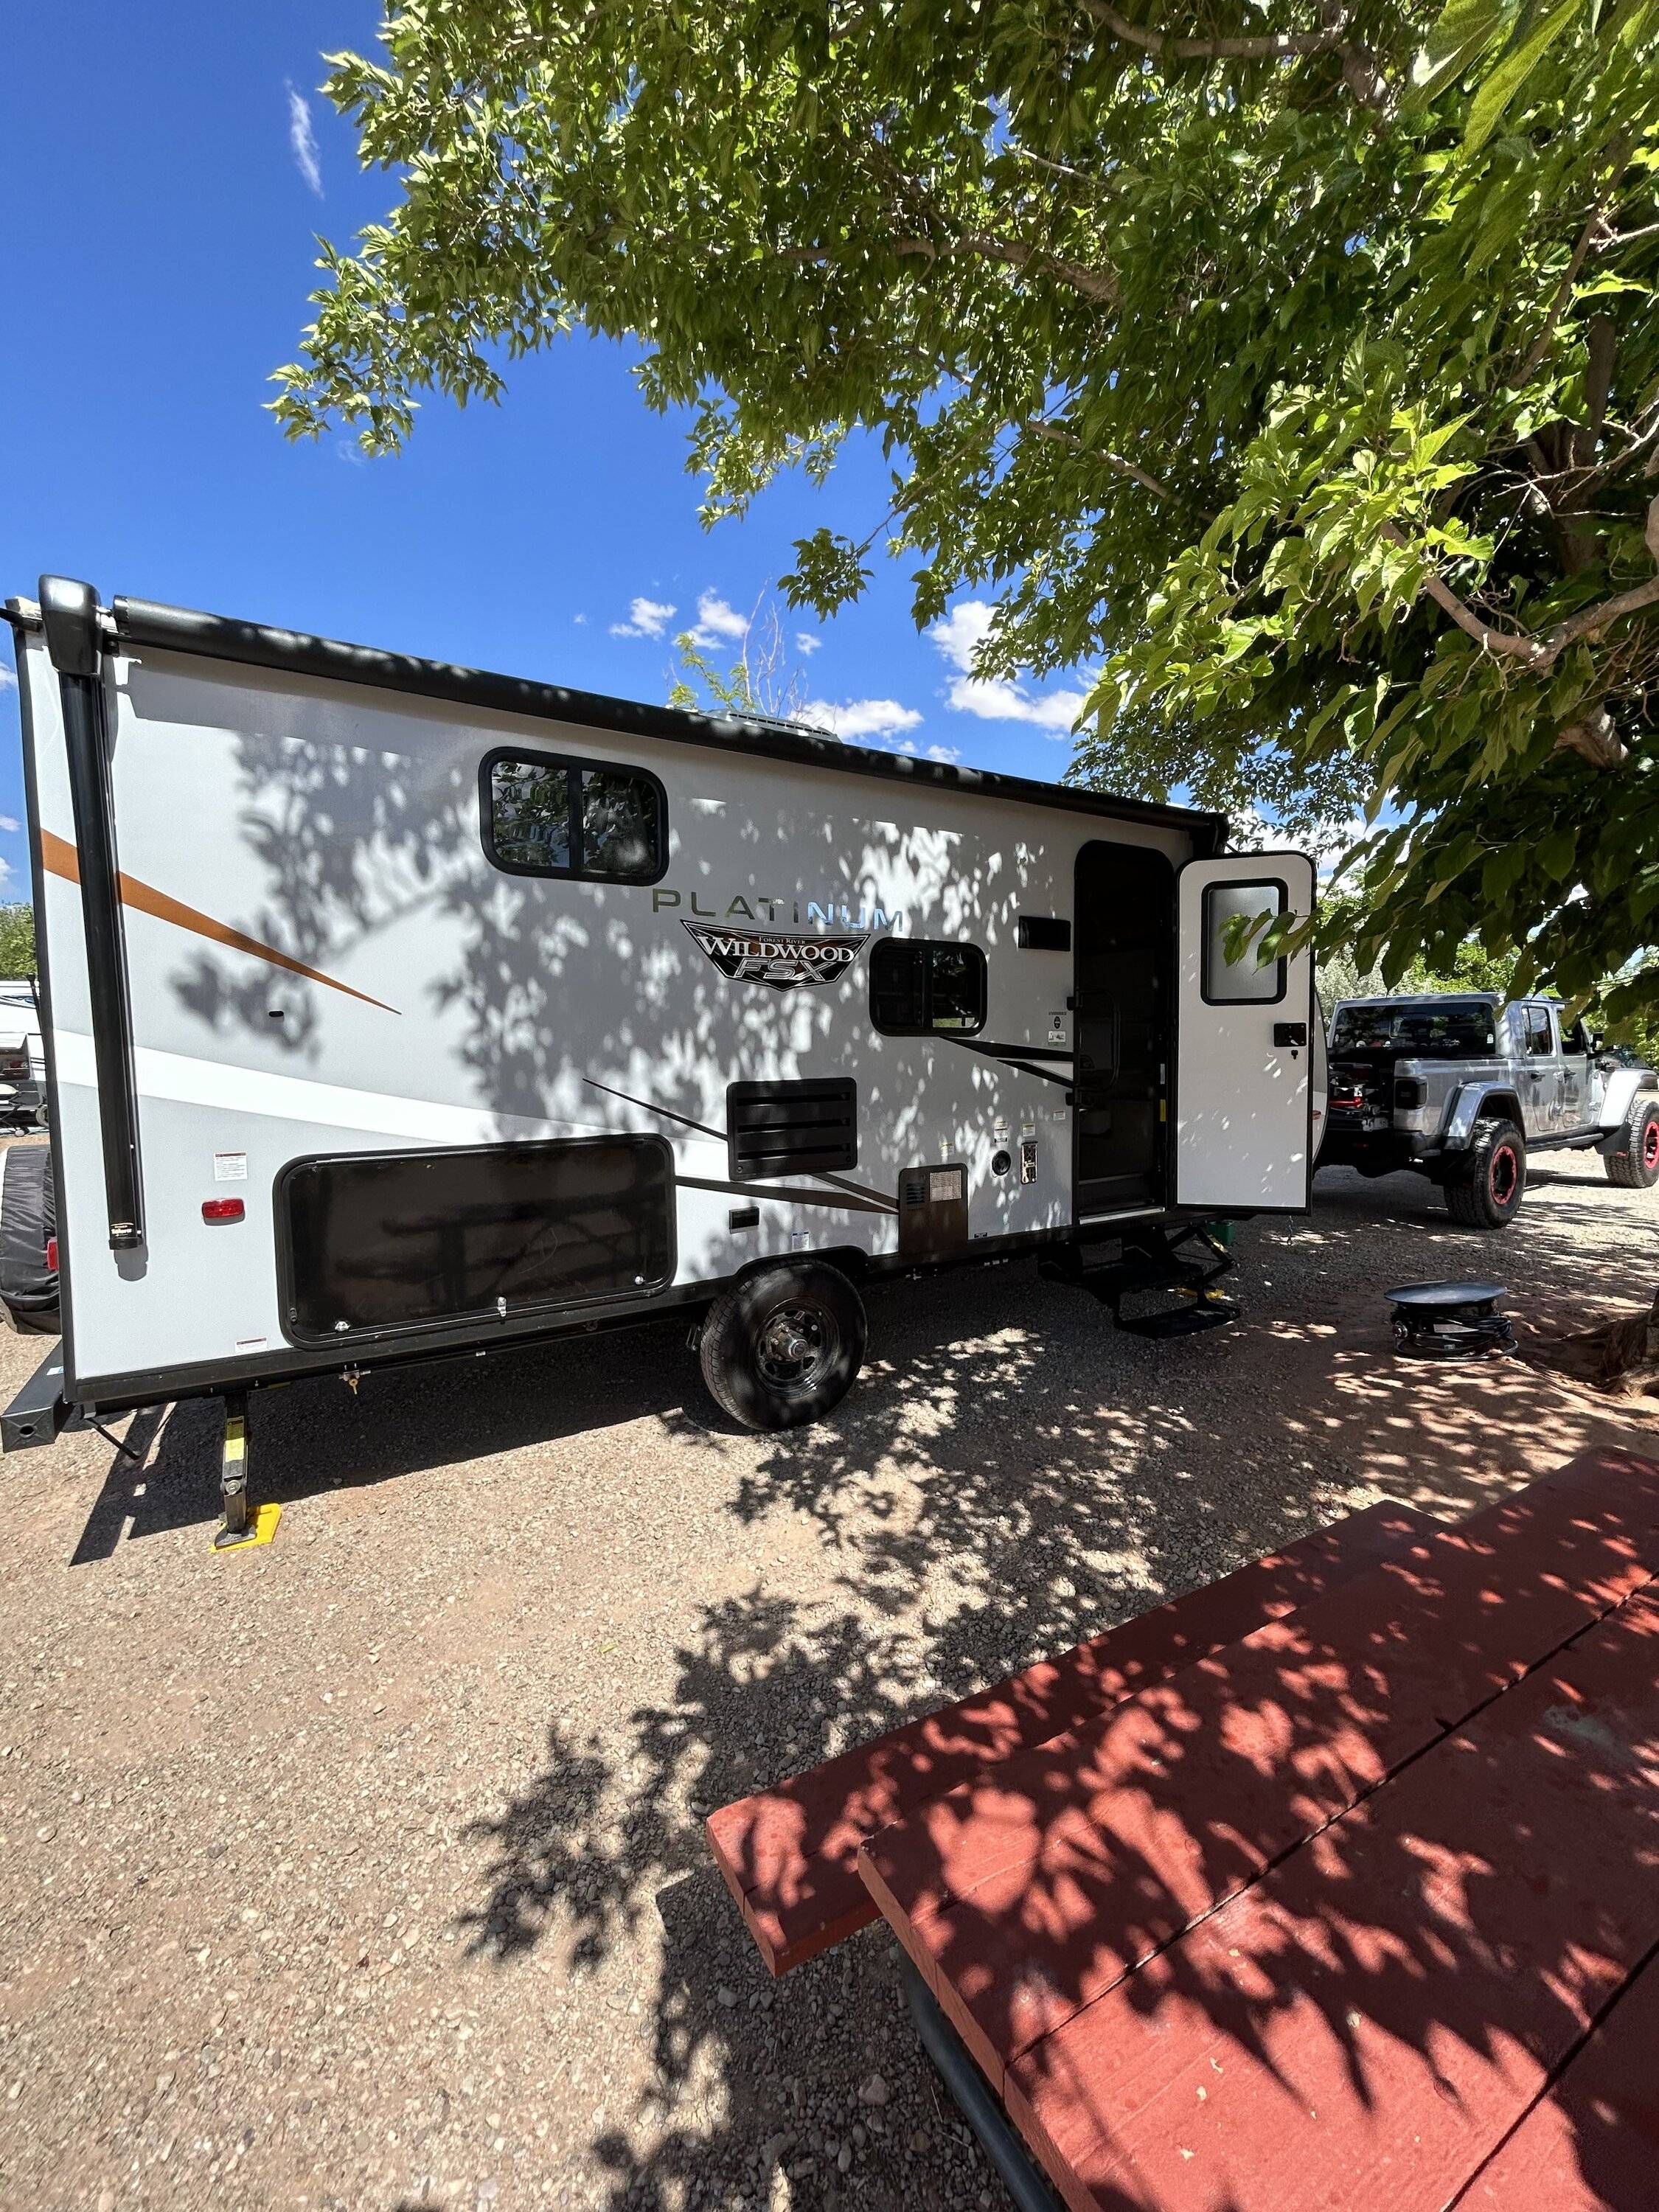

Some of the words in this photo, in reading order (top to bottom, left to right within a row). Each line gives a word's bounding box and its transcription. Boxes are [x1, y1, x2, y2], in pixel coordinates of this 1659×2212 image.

[653, 888, 903, 931] PLATINUM
[698, 936, 854, 961] WILDWOOD
[735, 958, 837, 981] FSX
